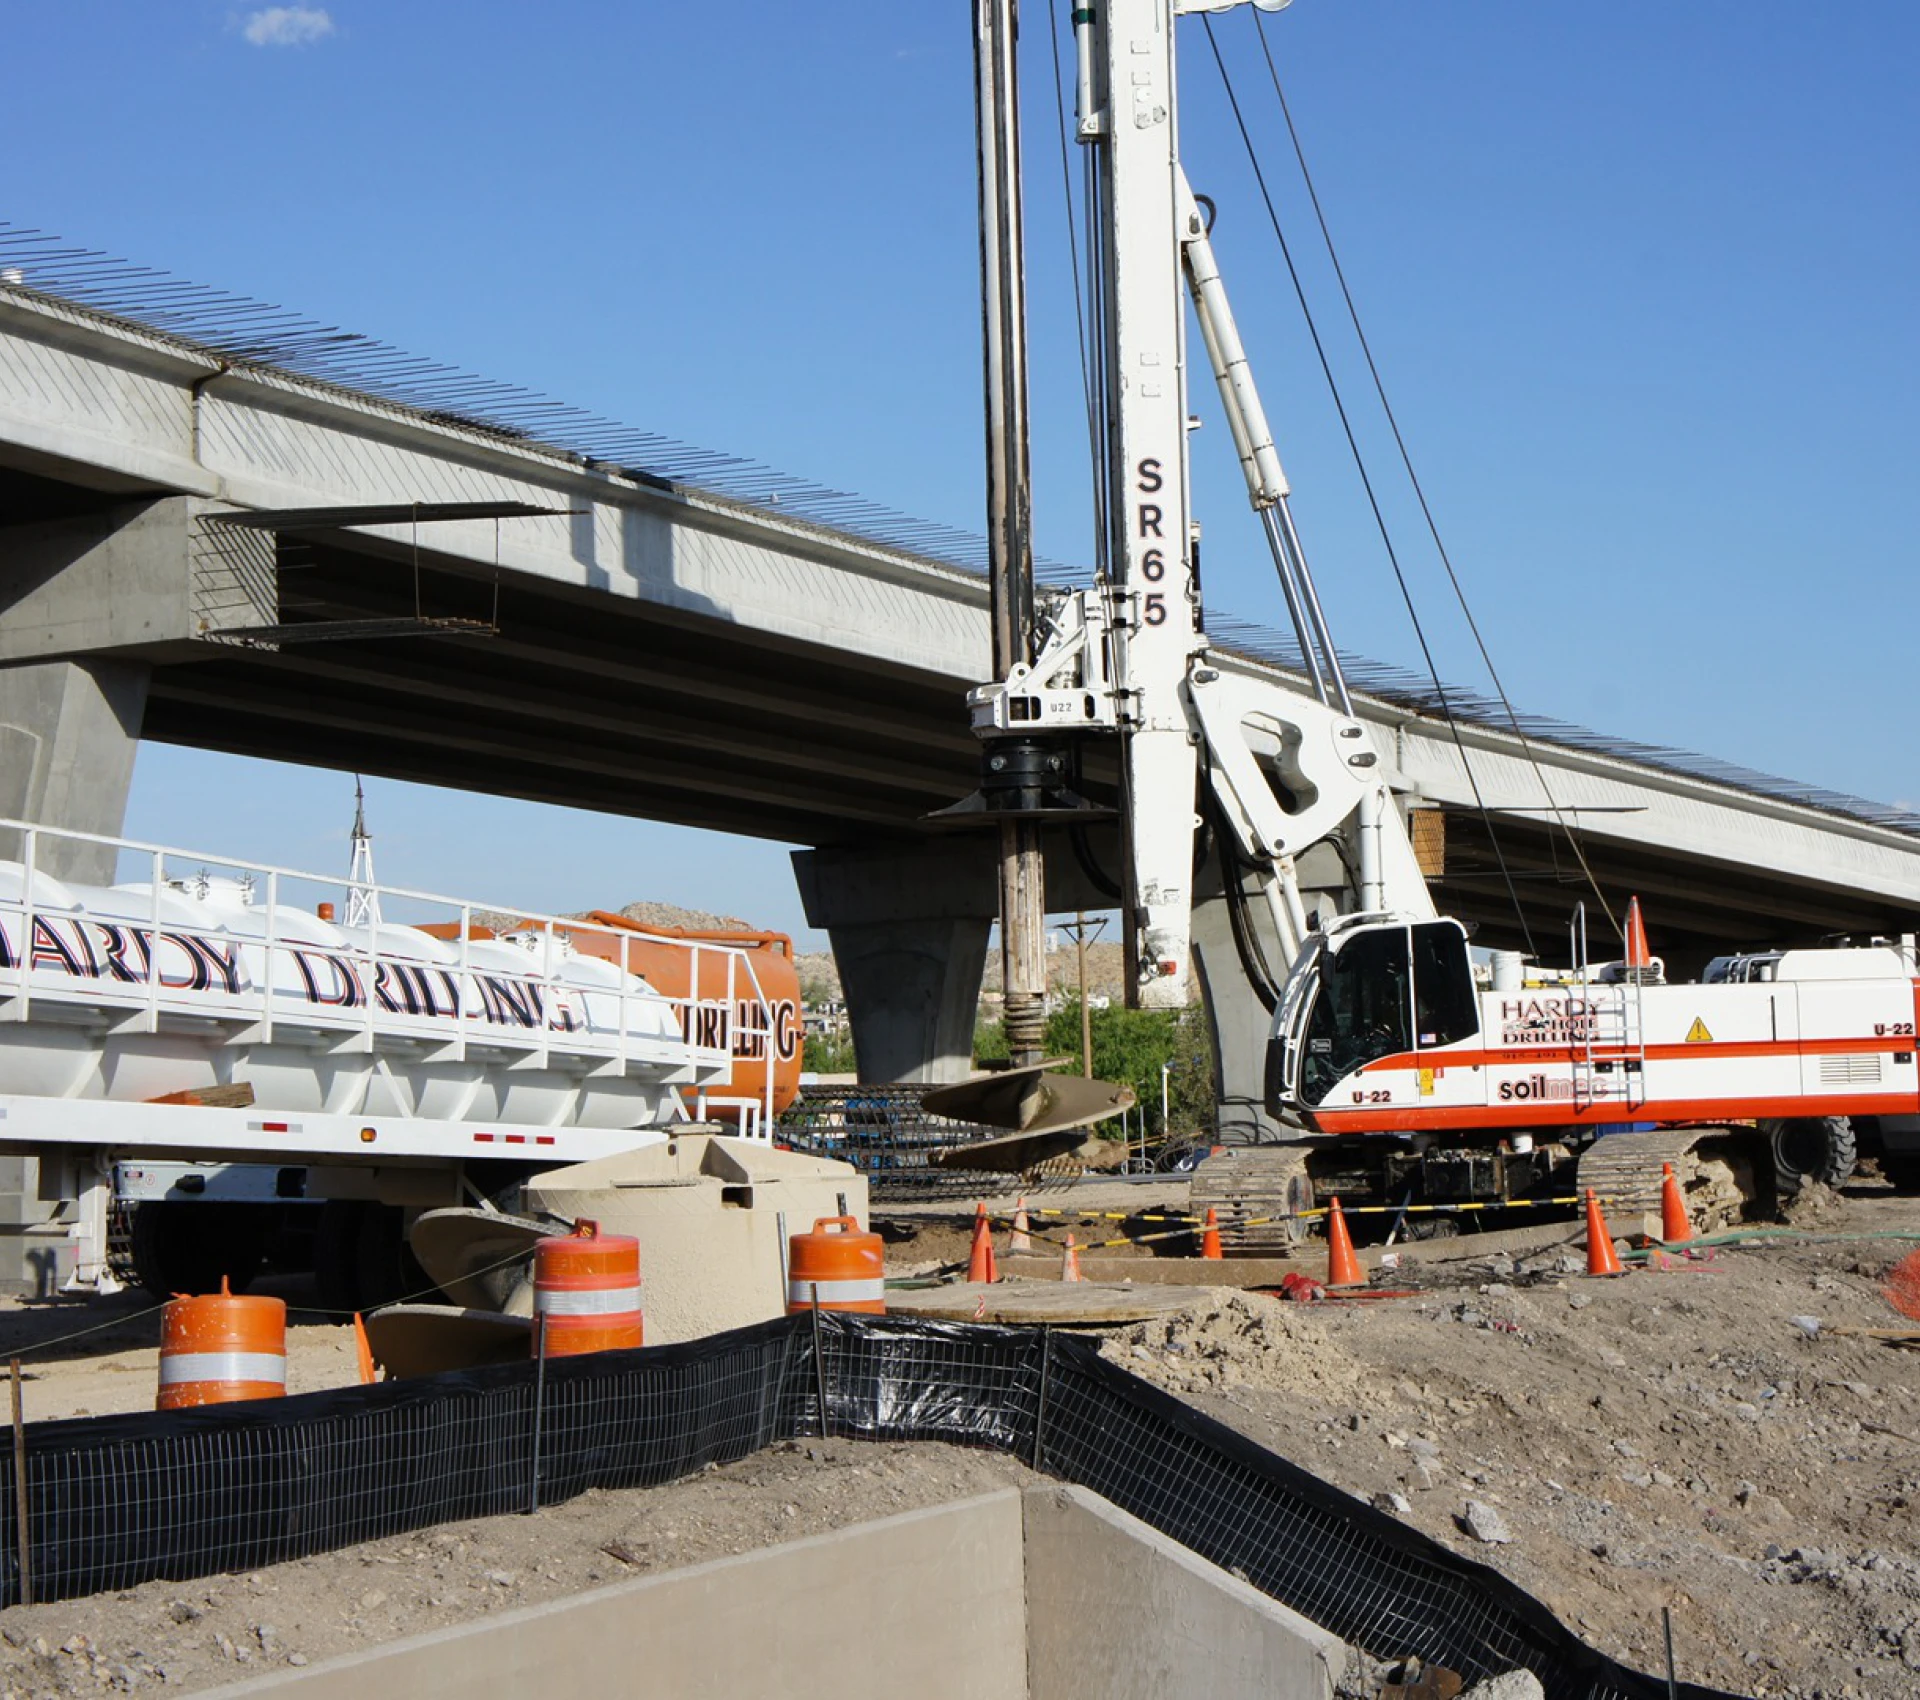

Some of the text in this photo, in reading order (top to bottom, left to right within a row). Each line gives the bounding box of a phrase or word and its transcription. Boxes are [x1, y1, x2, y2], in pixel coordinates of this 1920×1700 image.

[1137, 458, 1167, 626] SR65
[1050, 702, 1072, 712] U22
[0, 908, 243, 994] ARDY
[1501, 998, 1604, 1018] HARDY
[1873, 1022, 1914, 1036] U-22
[1351, 1090, 1391, 1103] U-22
